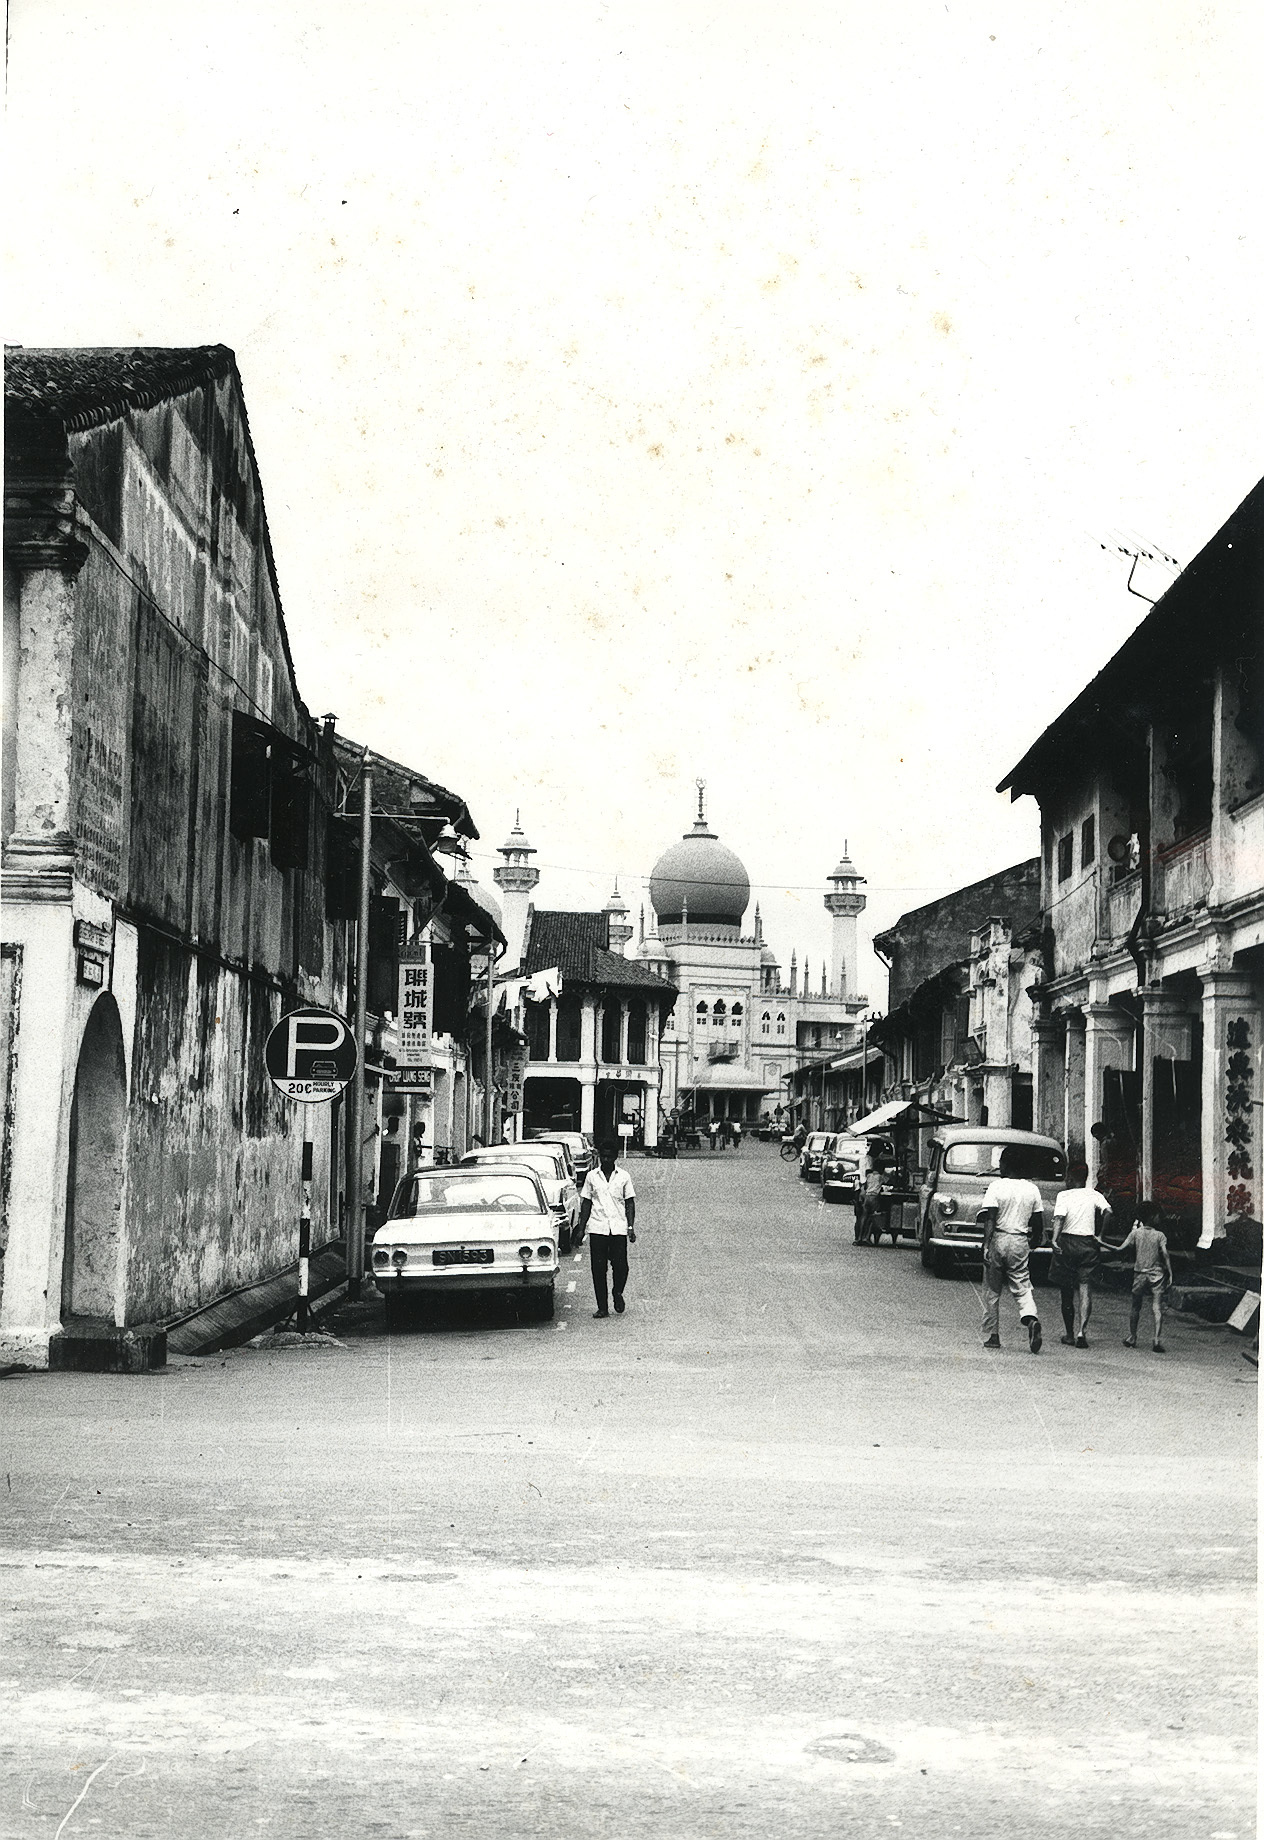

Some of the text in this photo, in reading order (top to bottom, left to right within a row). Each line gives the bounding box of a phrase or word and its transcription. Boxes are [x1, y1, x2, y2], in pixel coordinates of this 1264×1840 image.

[403, 968, 428, 1030] 聯城號
[286, 1016, 346, 1078] P
